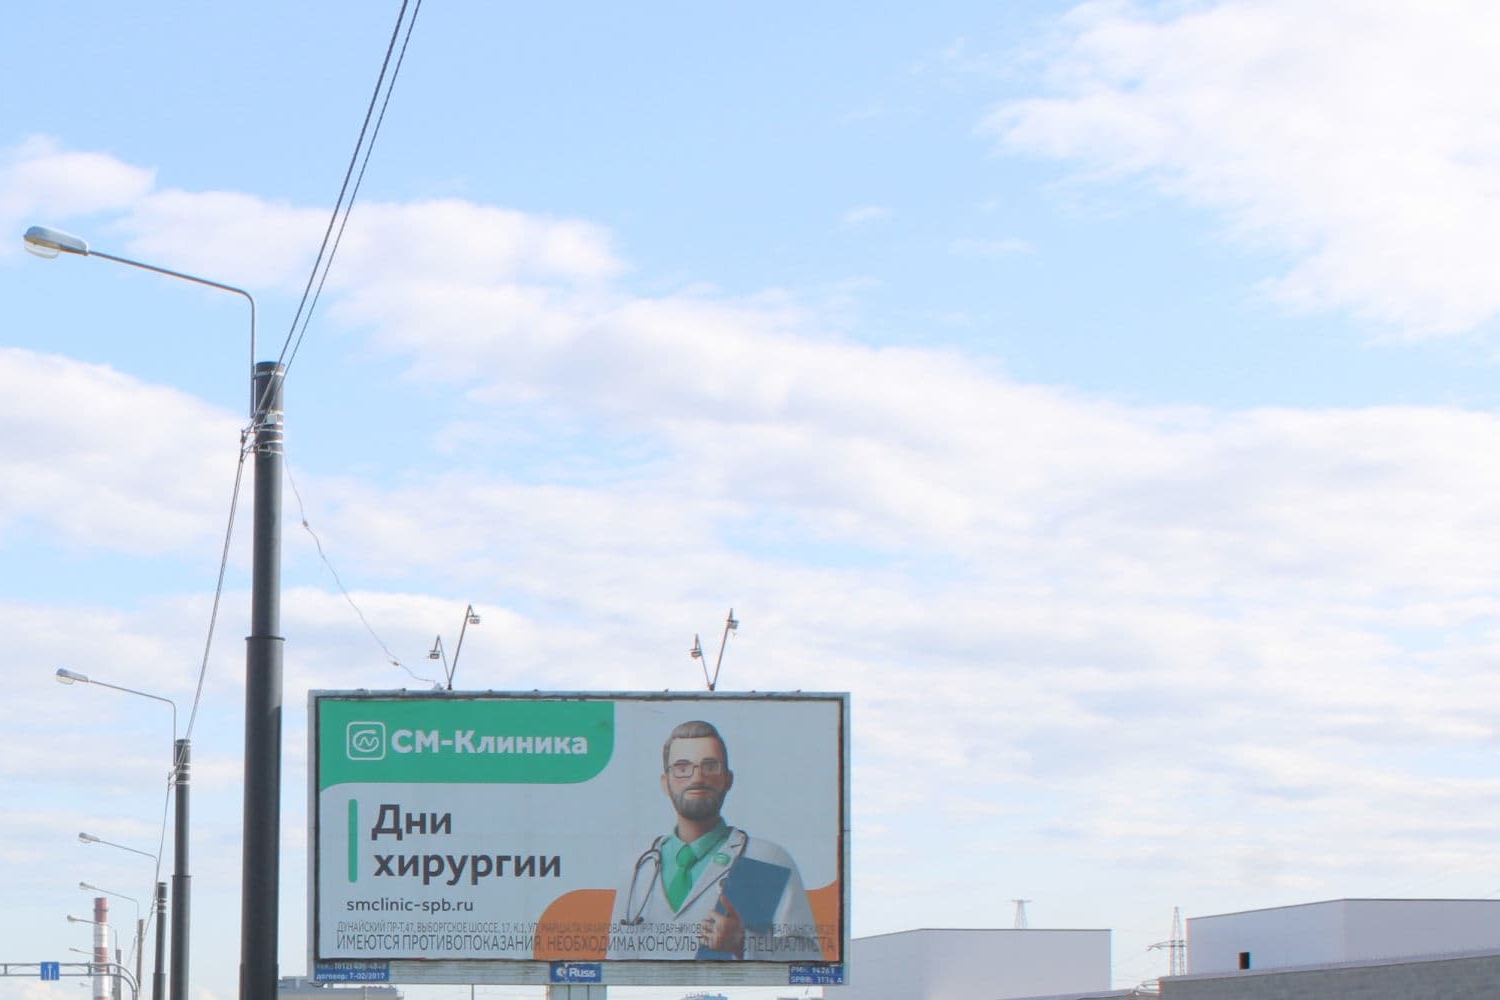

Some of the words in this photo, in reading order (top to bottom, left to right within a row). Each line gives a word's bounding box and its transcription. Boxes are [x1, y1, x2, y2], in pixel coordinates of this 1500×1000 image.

[391, 729, 589, 755] СМ-Клиника
[371, 804, 452, 841] Дни
[373, 854, 561, 886] хирургии
[347, 898, 474, 915] smclinic-spb.ru
[337, 920, 388, 934] ДУНАЙСКИЙ
[417, 921, 467, 934] ВЫБОРГСКОЕ
[337, 934, 399, 950] ИМЕЮТСЯ
[548, 935, 636, 952] НЕОБХОДИМА
[638, 935, 734, 952] КОНСУЛЬТ
[569, 967, 597, 978] Russ
